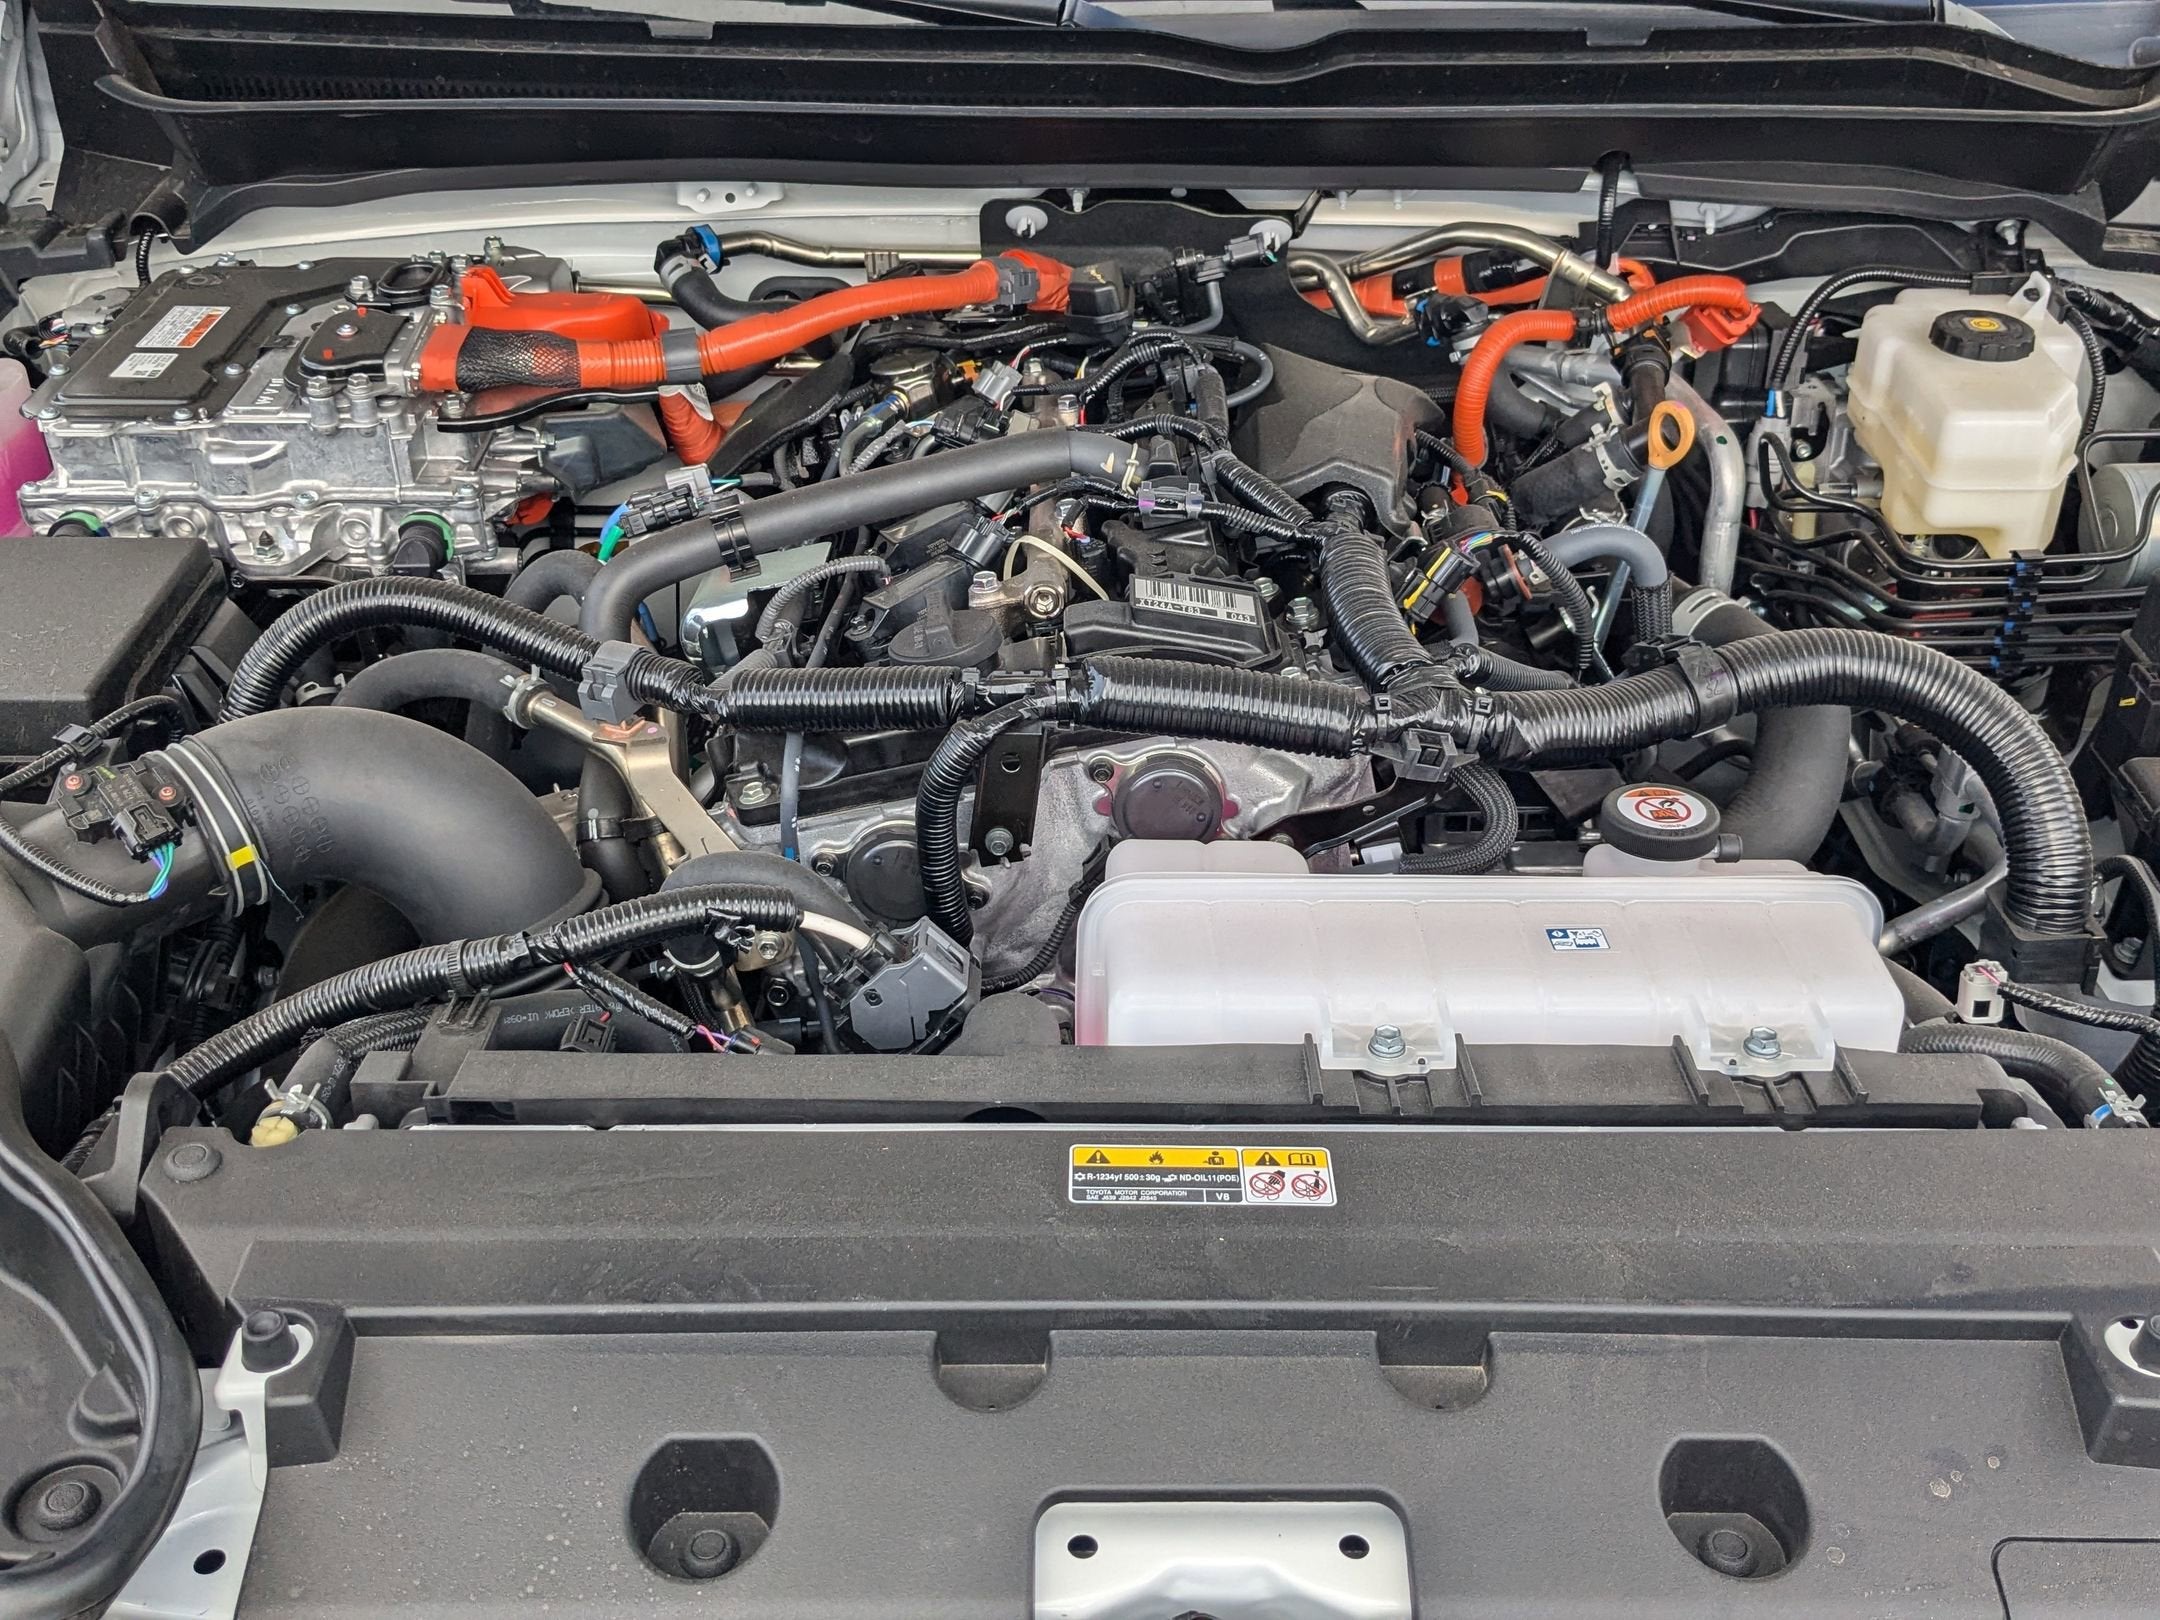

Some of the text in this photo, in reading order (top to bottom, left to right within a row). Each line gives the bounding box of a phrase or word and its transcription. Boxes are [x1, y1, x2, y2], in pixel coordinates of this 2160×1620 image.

[1139, 598, 1251, 622] XT24A-T83 043
[1087, 1173, 1123, 1182] R-1234yf
[1179, 1173, 1239, 1183] ND-OIL11(POE)
[1216, 1192, 1230, 1201] V8
